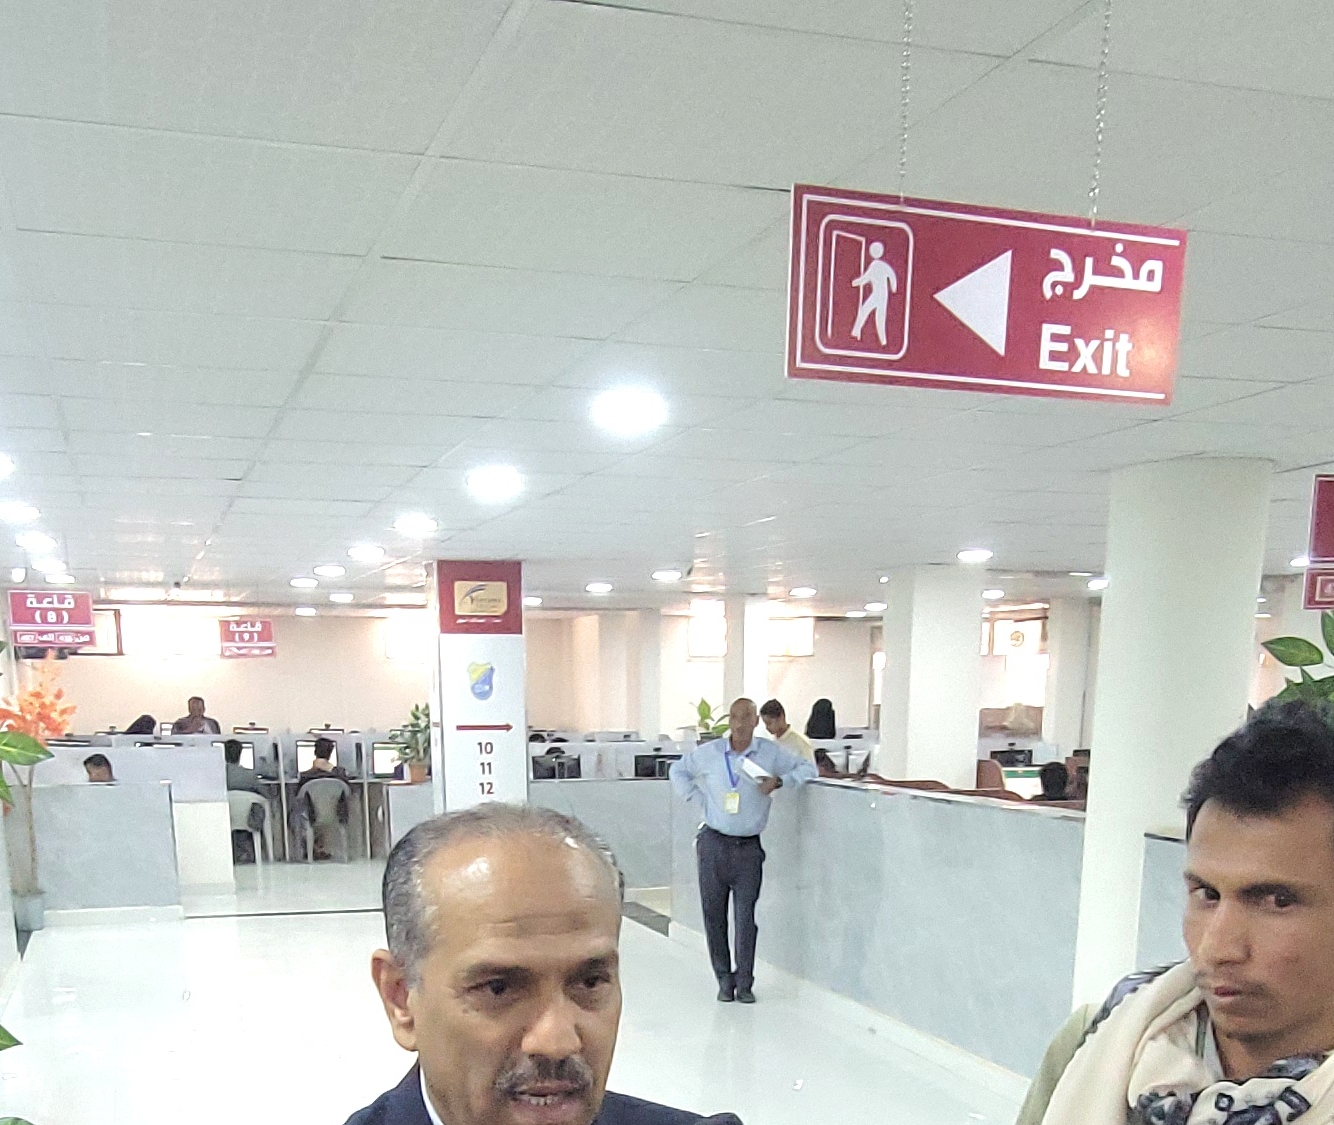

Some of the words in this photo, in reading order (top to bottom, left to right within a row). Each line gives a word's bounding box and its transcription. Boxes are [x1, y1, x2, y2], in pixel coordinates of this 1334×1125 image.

[1042, 242, 1164, 301] مخرج
[1038, 322, 1133, 377] Exit
[26, 593, 75, 609] قاعة
[229, 620, 262, 632] قاعة
[477, 741, 494, 755] 10
[480, 762, 492, 775] 11
[479, 782, 495, 795] 12
